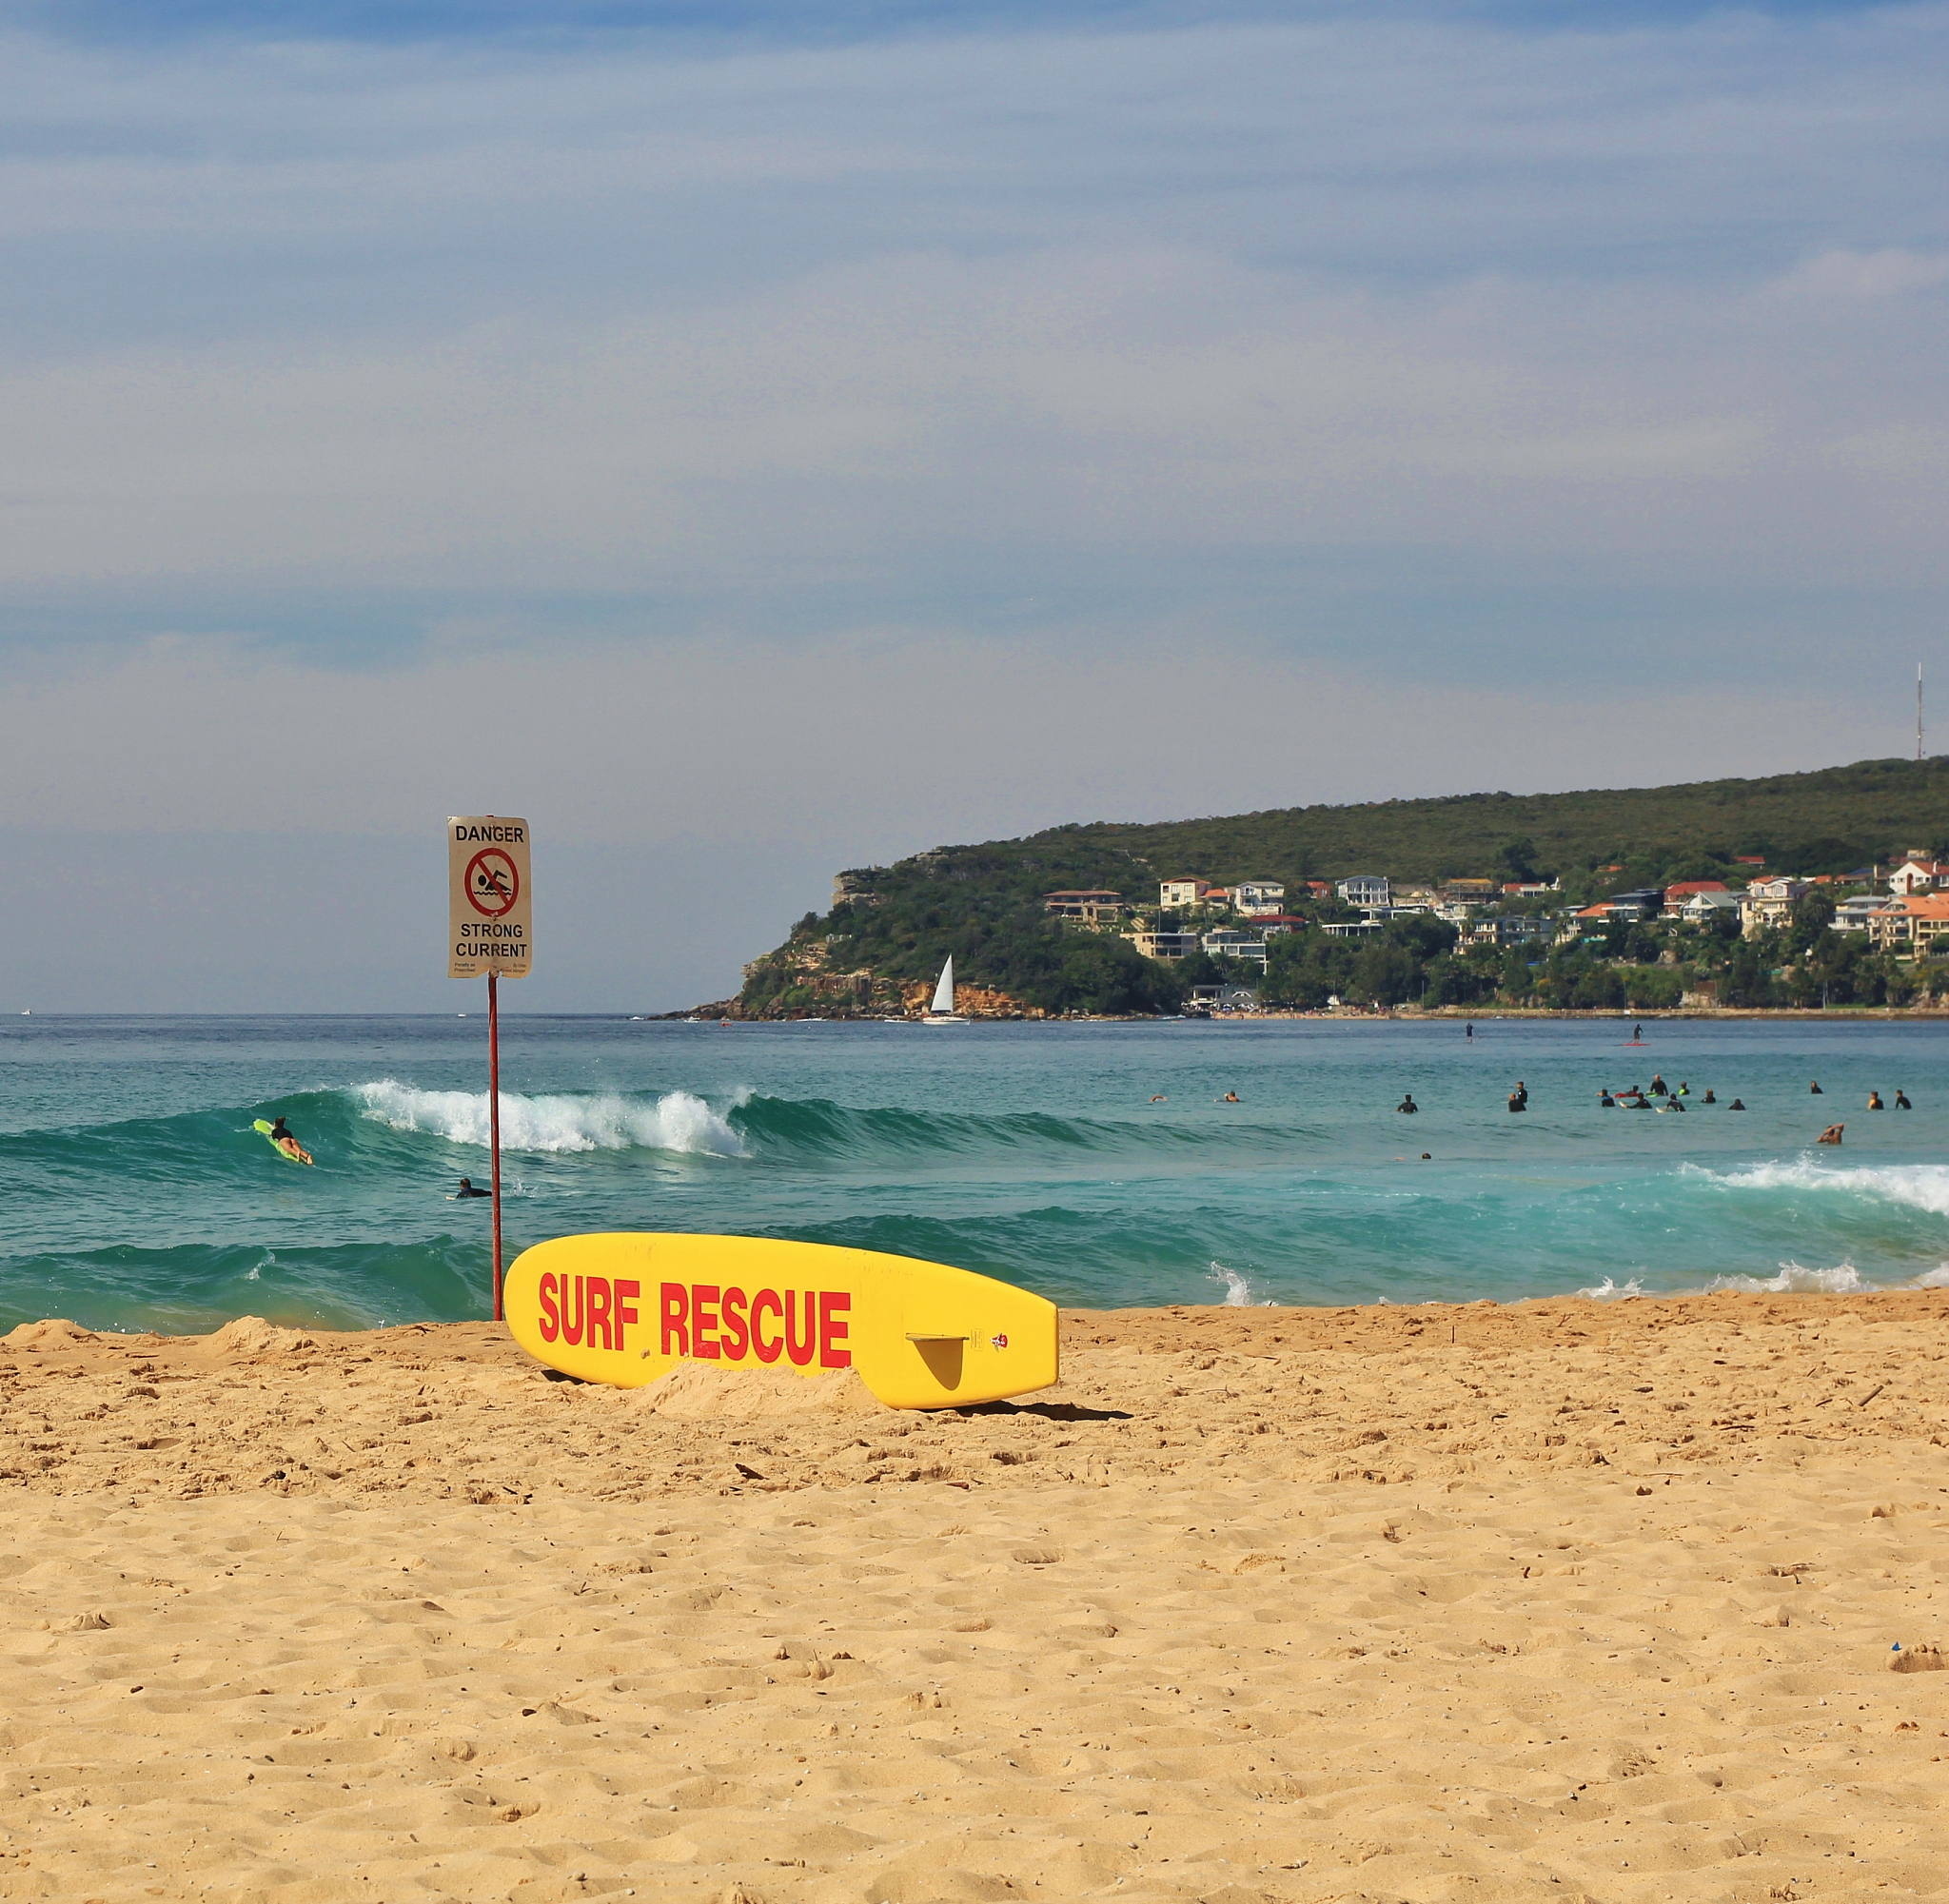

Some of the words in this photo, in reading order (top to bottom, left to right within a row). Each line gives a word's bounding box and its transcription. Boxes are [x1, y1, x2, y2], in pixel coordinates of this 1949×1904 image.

[456, 826, 524, 843] DANGER
[461, 923, 522, 938] STRONG
[456, 943, 527, 957] CURRENT
[539, 1272, 640, 1351] SURF
[660, 1282, 852, 1368] RESCUE
